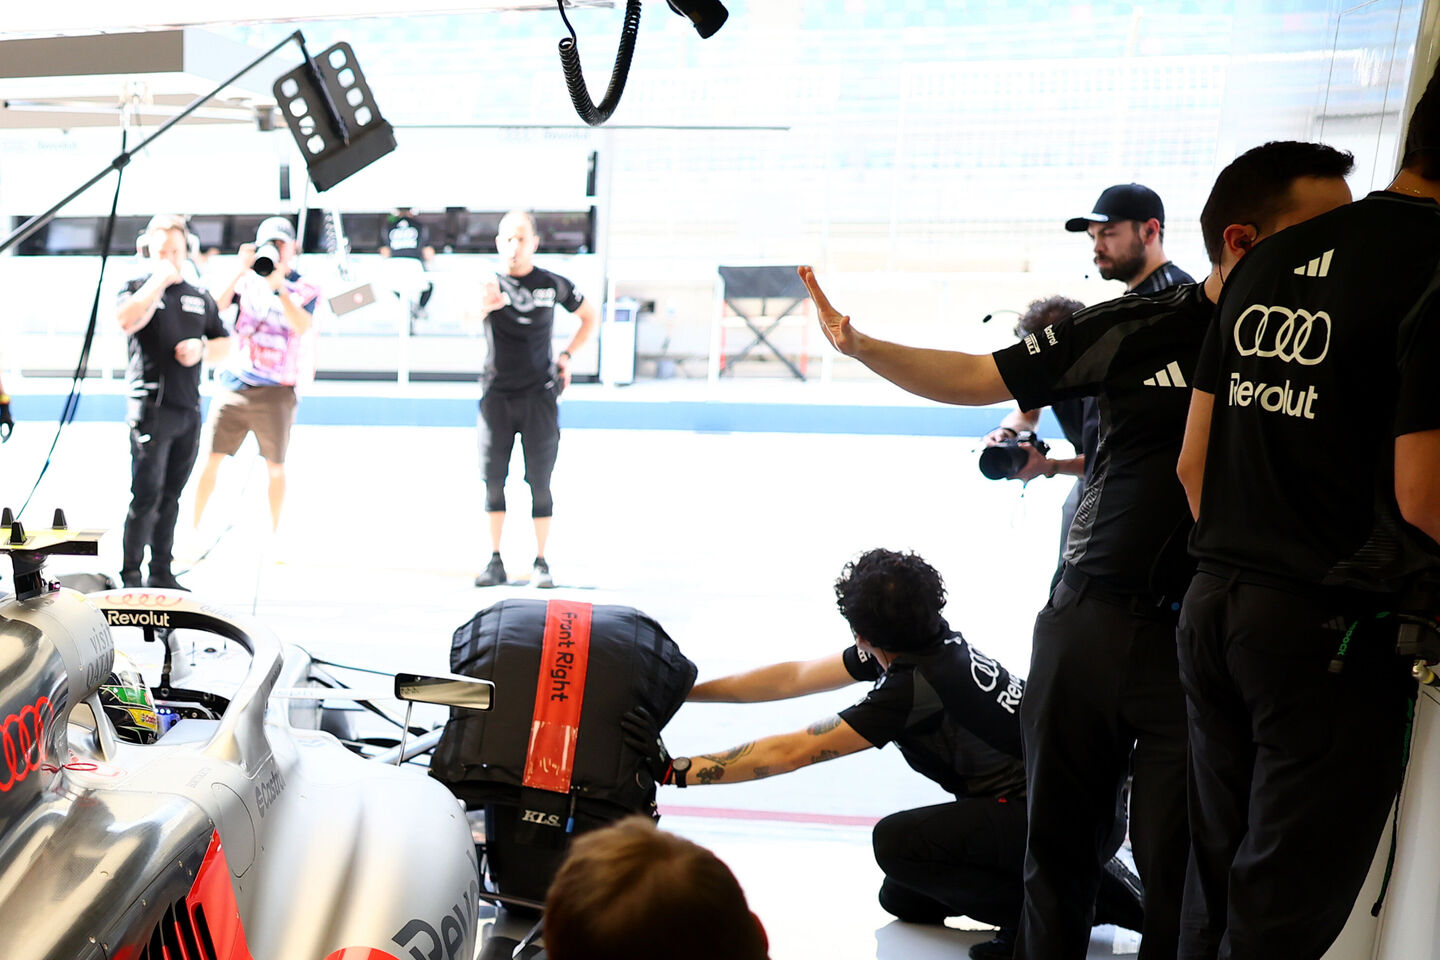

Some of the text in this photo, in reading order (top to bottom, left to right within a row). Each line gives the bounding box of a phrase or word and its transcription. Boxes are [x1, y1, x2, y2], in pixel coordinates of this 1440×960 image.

[1228, 372, 1319, 420] Revolut
[107, 610, 170, 628] Revolut
[551, 610, 579, 703] Front Right
